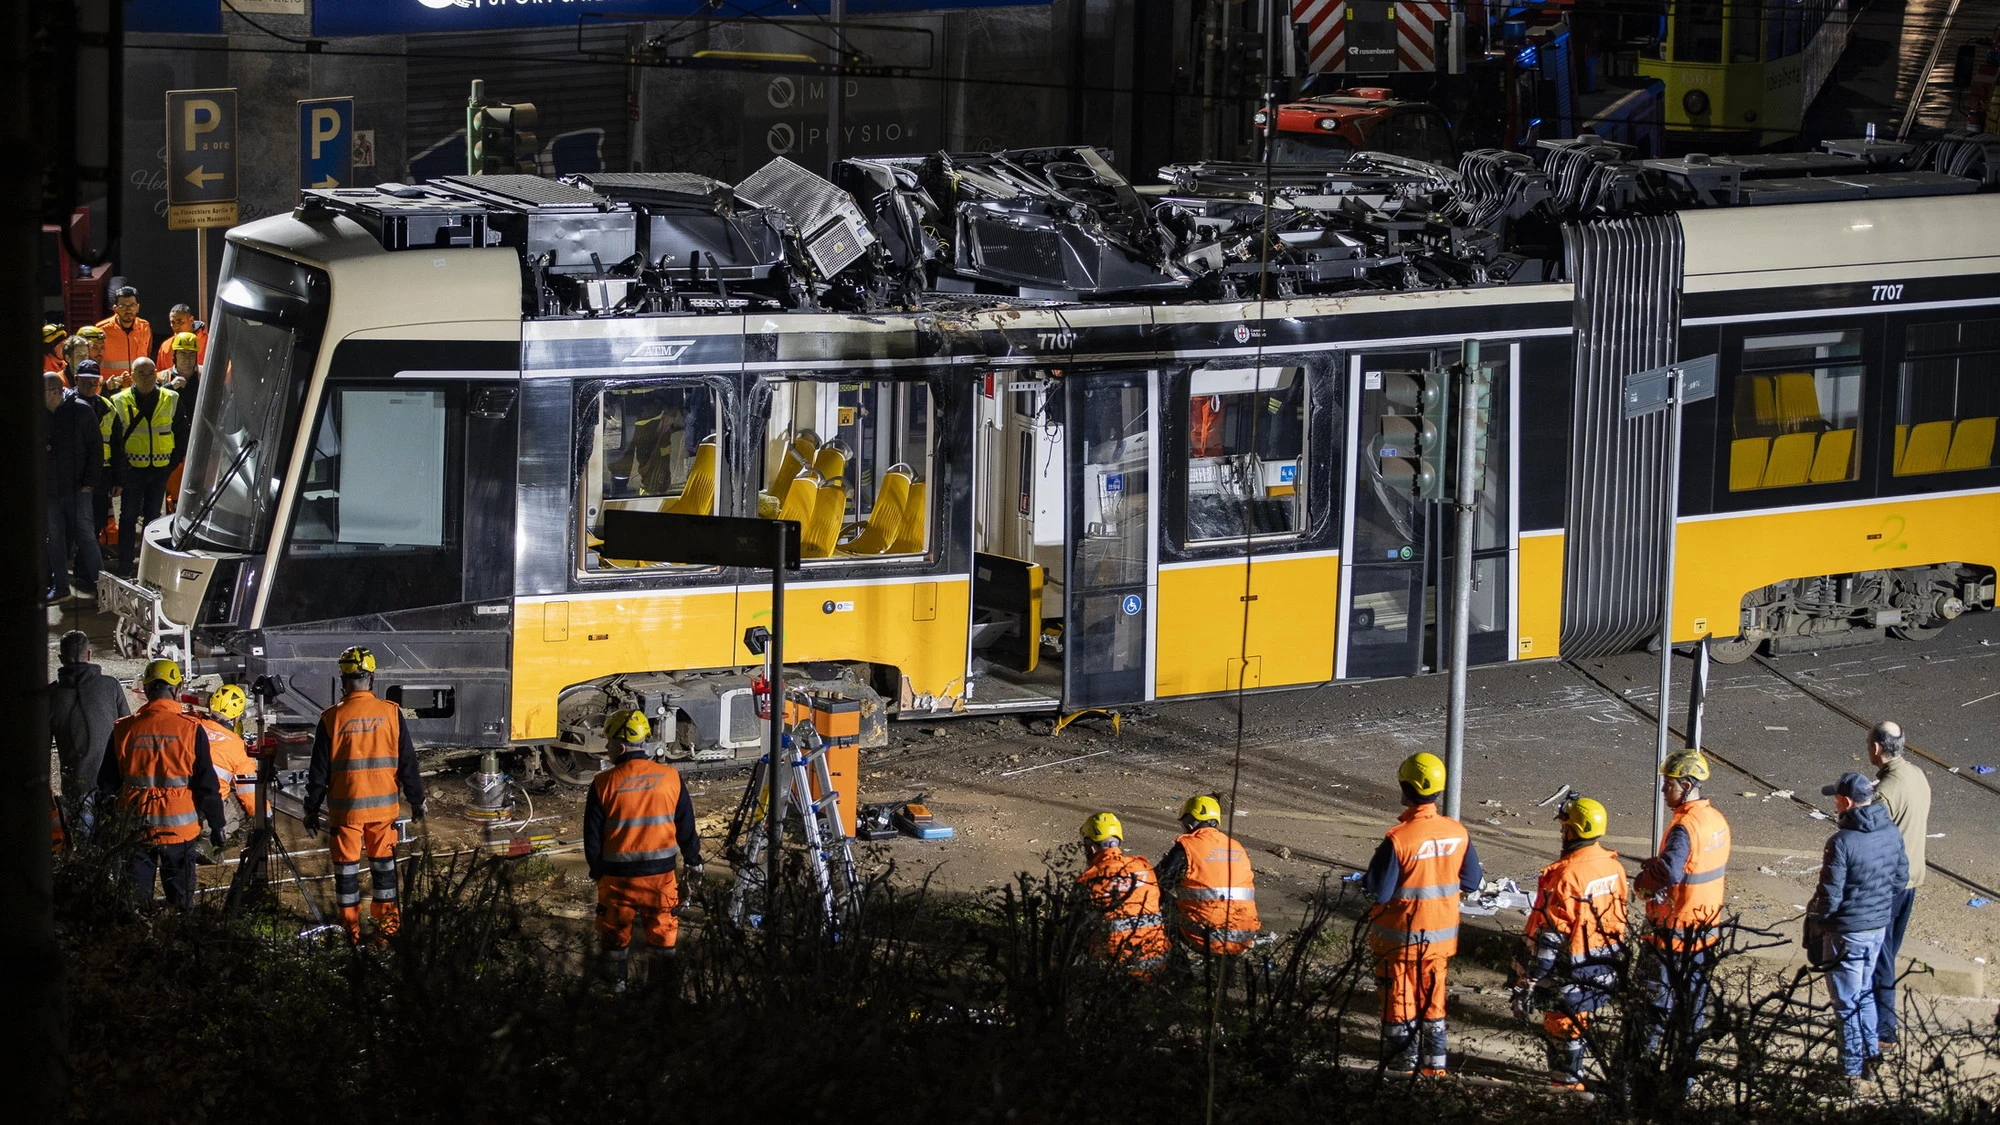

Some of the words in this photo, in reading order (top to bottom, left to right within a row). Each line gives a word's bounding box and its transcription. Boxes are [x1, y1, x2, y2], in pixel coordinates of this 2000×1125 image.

[1360, 47, 1395, 55] rosenbauer
[810, 81, 859, 99] MD
[184, 99, 221, 151] P
[312, 108, 341, 160] P
[809, 123, 901, 145] PYSIO
[213, 141, 231, 150] ore
[1872, 284, 1904, 301] 7707
[1037, 333, 1077, 350] 7707
